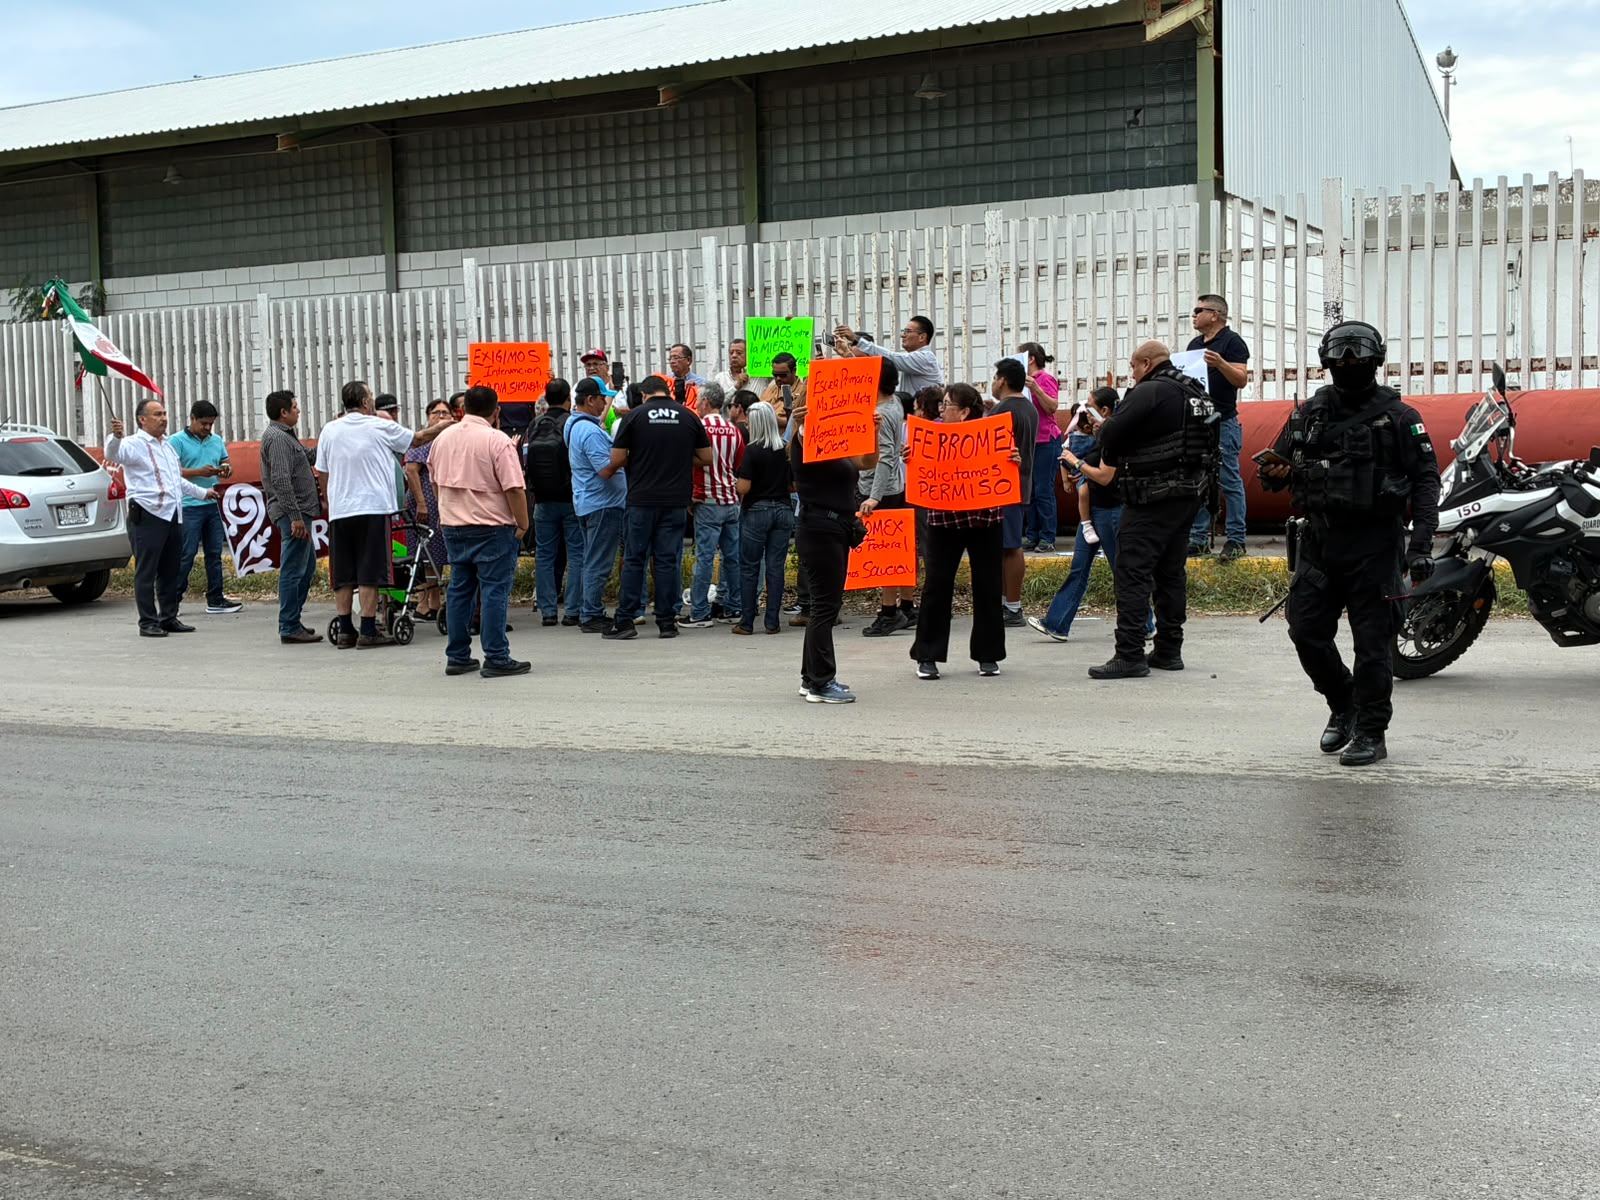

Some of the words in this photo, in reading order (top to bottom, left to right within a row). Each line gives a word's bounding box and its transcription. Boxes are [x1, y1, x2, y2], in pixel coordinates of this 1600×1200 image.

[750, 341, 758, 354] la
[760, 340, 794, 354] MIERDA
[799, 343, 803, 353] y
[473, 348, 541, 366] EXIGIMOS
[751, 356, 762, 369] los
[840, 367, 873, 390] Primaria
[648, 408, 679, 419] CNT
[704, 426, 735, 435] TOYOTA
[918, 478, 1012, 502] PERMISO
[1456, 502, 1482, 518] 150
[864, 518, 904, 536] OMEX
